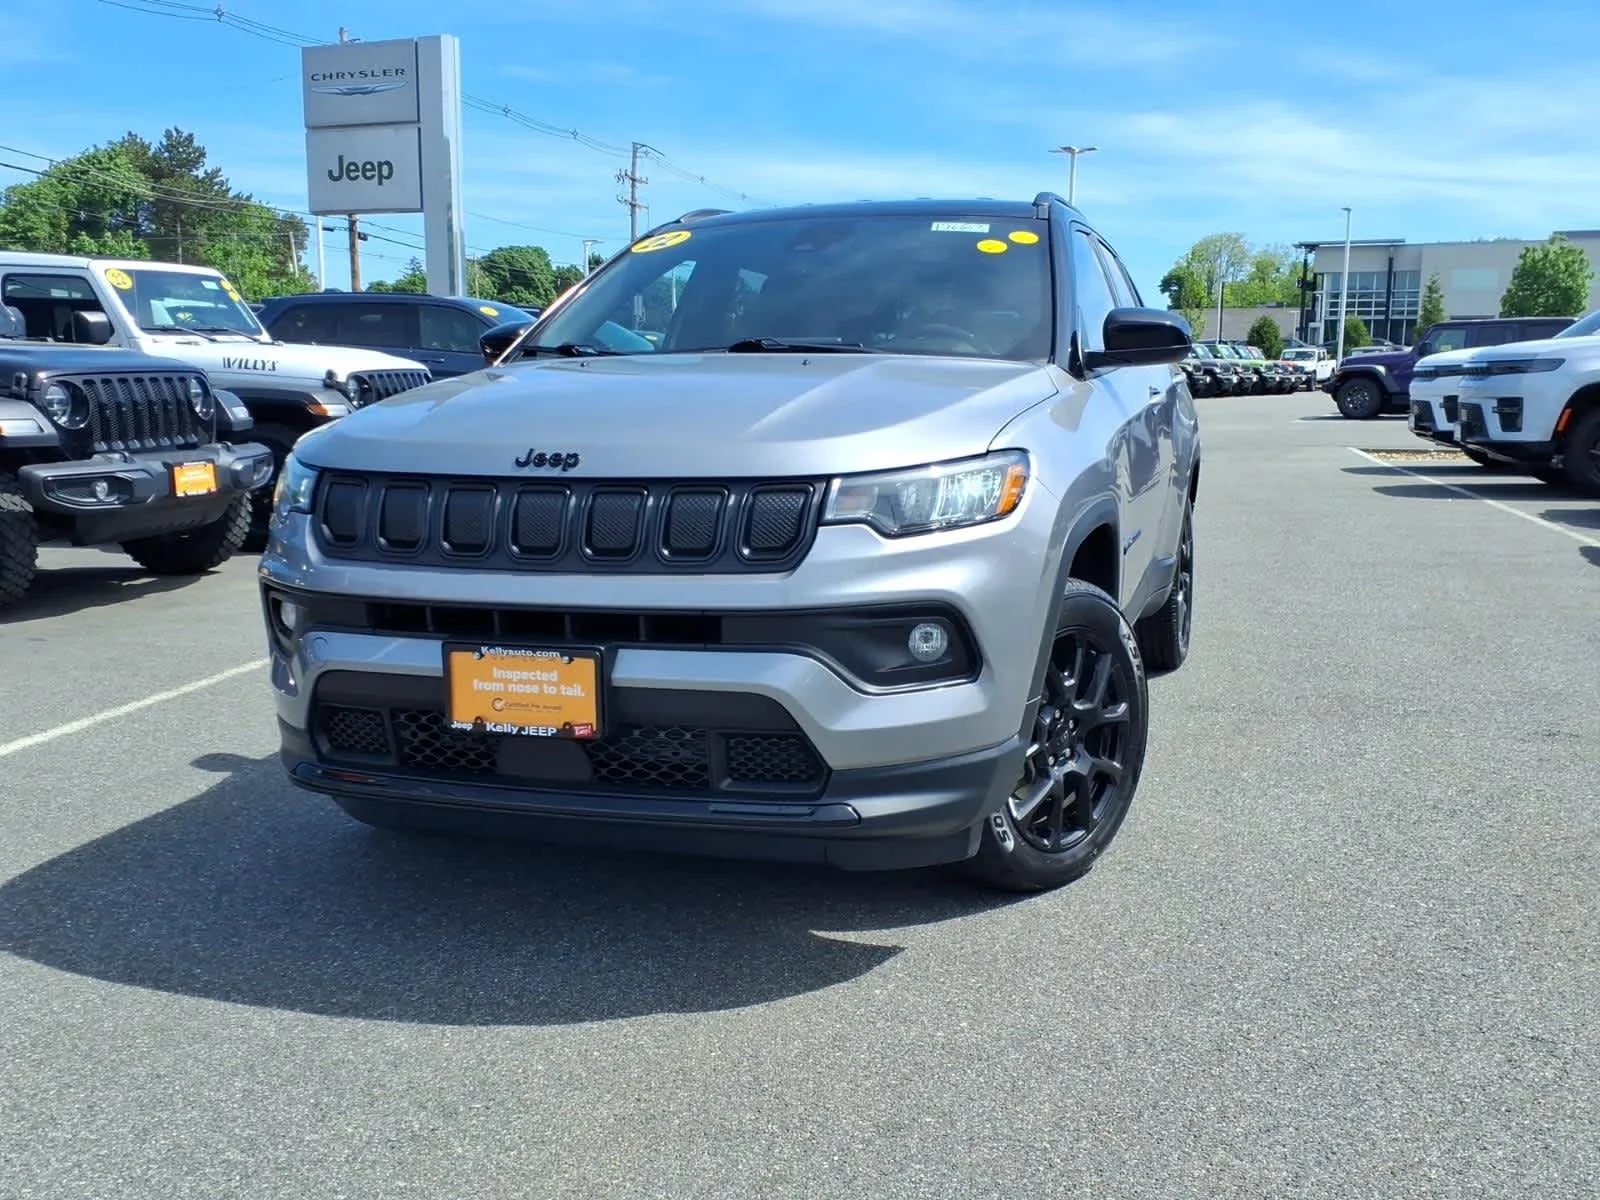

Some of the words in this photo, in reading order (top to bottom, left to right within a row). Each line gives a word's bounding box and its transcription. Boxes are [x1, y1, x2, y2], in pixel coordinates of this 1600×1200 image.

[311, 68, 406, 82] CHRYSLER
[327, 154, 394, 186] Jeep
[222, 357, 280, 371] WILLYS
[514, 447, 580, 473] Jeep
[480, 646, 561, 658] Kellyauto.com
[492, 667, 558, 682] Inspected
[472, 680, 504, 692] from
[507, 684, 539, 693] nose
[543, 684, 557, 694] to
[561, 683, 585, 697] tail.
[486, 722, 521, 735] Kelly
[520, 726, 557, 737] JEEP
